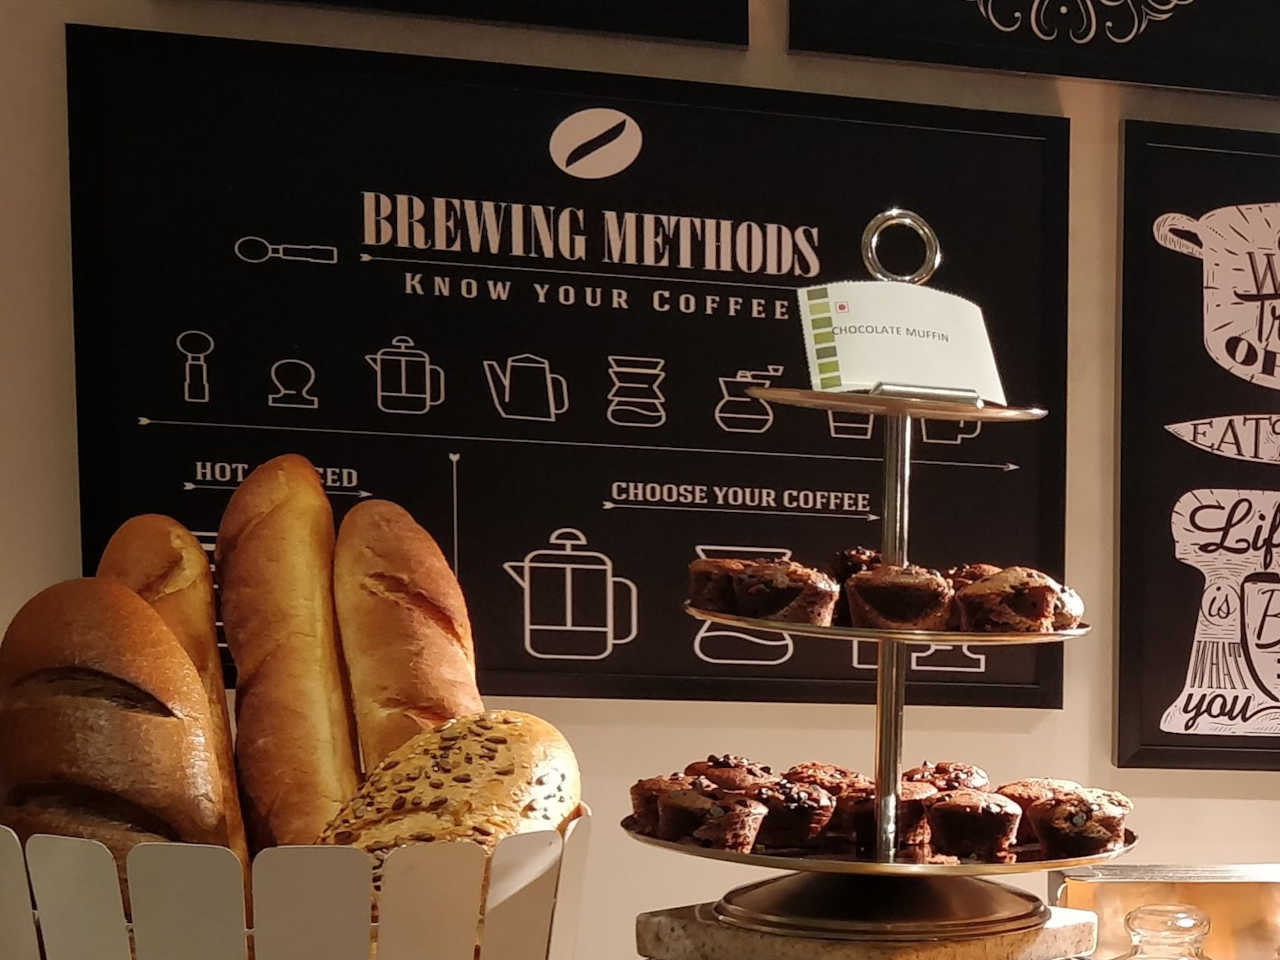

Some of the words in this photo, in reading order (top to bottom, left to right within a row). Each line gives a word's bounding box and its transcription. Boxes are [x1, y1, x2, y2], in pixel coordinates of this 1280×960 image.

[360, 190, 586, 262] BREWING
[602, 209, 821, 278] METHODS
[404, 272, 511, 301] KNOW
[533, 281, 630, 310] YOUR
[652, 290, 791, 320] COFFEE
[831, 324, 902, 336] CHOCOLATE
[905, 327, 950, 343] MUFFIN
[195, 460, 249, 483] HOT
[611, 480, 709, 504] CHOOSE
[712, 485, 779, 508] YOUR
[782, 488, 872, 511] COFFEE
[1207, 585, 1231, 619] is
[1190, 639, 1252, 690] WHAT
[1182, 688, 1256, 731] you
